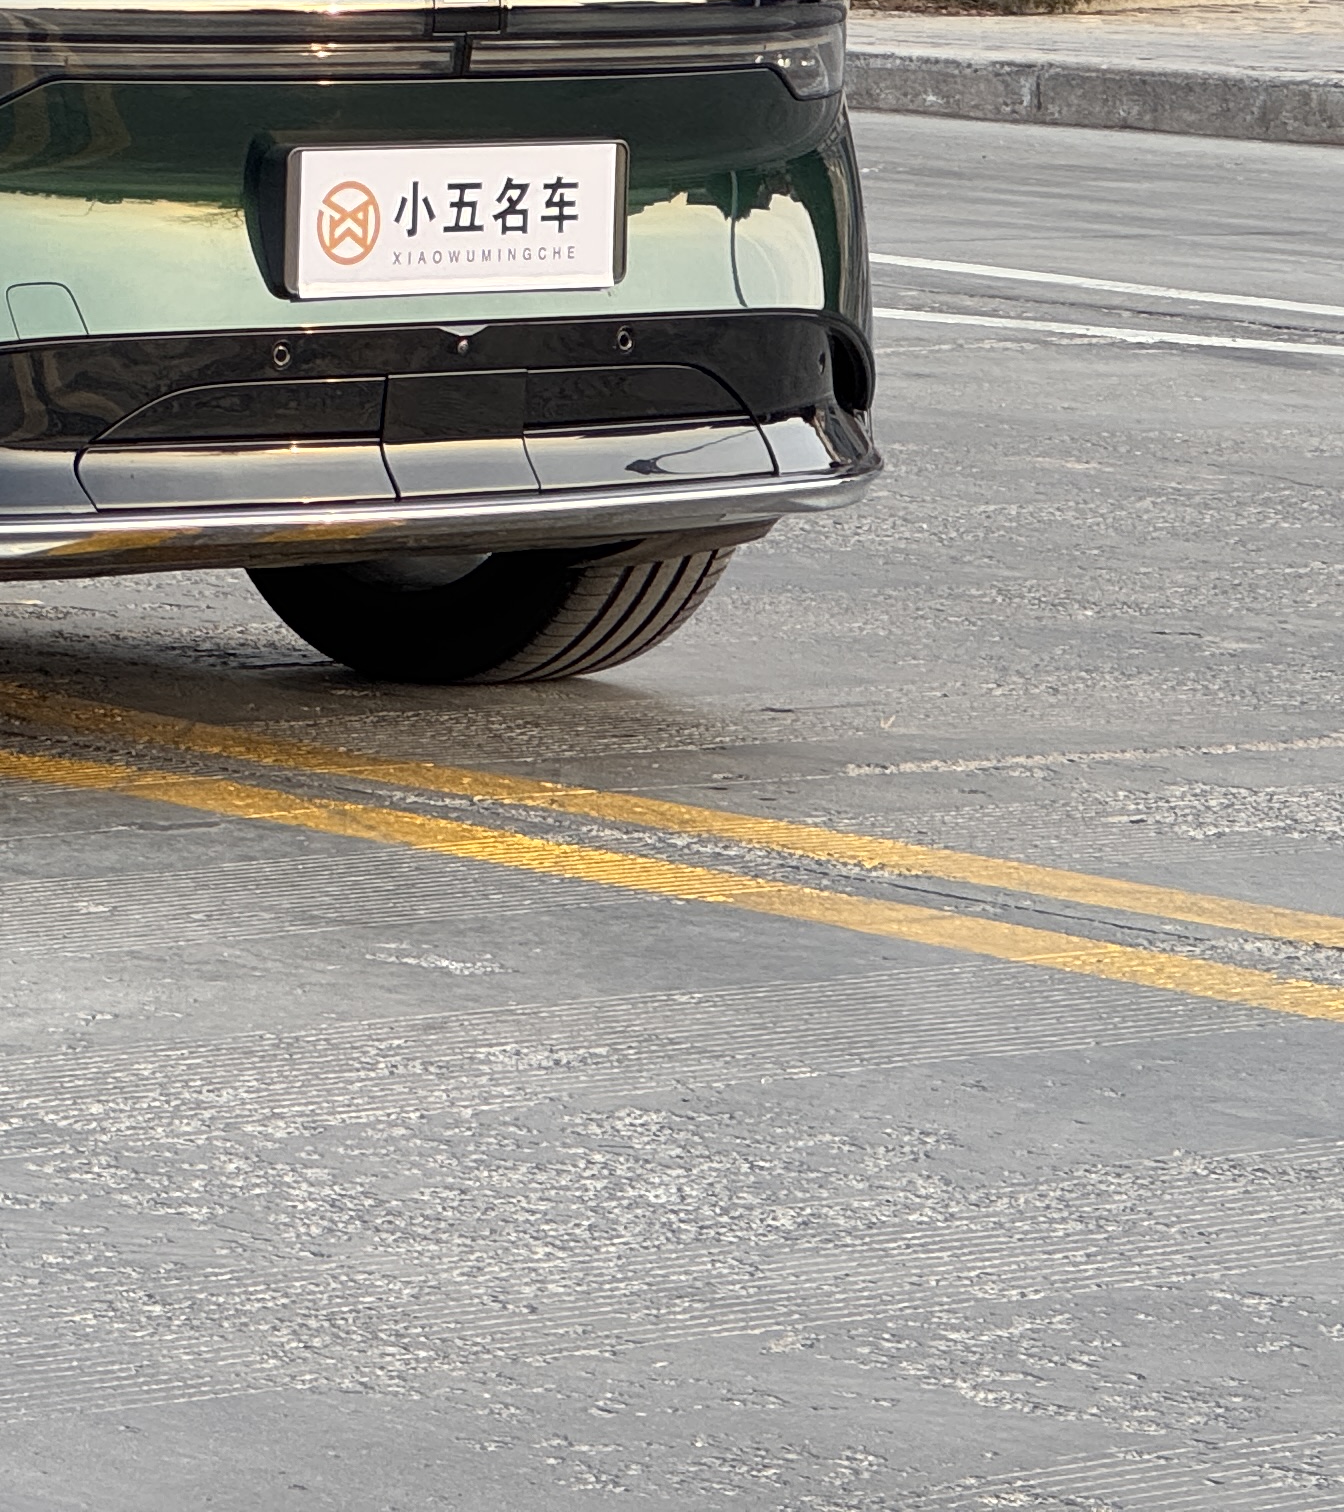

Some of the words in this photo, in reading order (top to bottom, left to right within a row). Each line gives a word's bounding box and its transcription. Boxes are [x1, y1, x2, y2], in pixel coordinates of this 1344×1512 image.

[393, 176, 580, 238] 小五名车
[392, 244, 577, 266] XIAOWUMINGCHE
